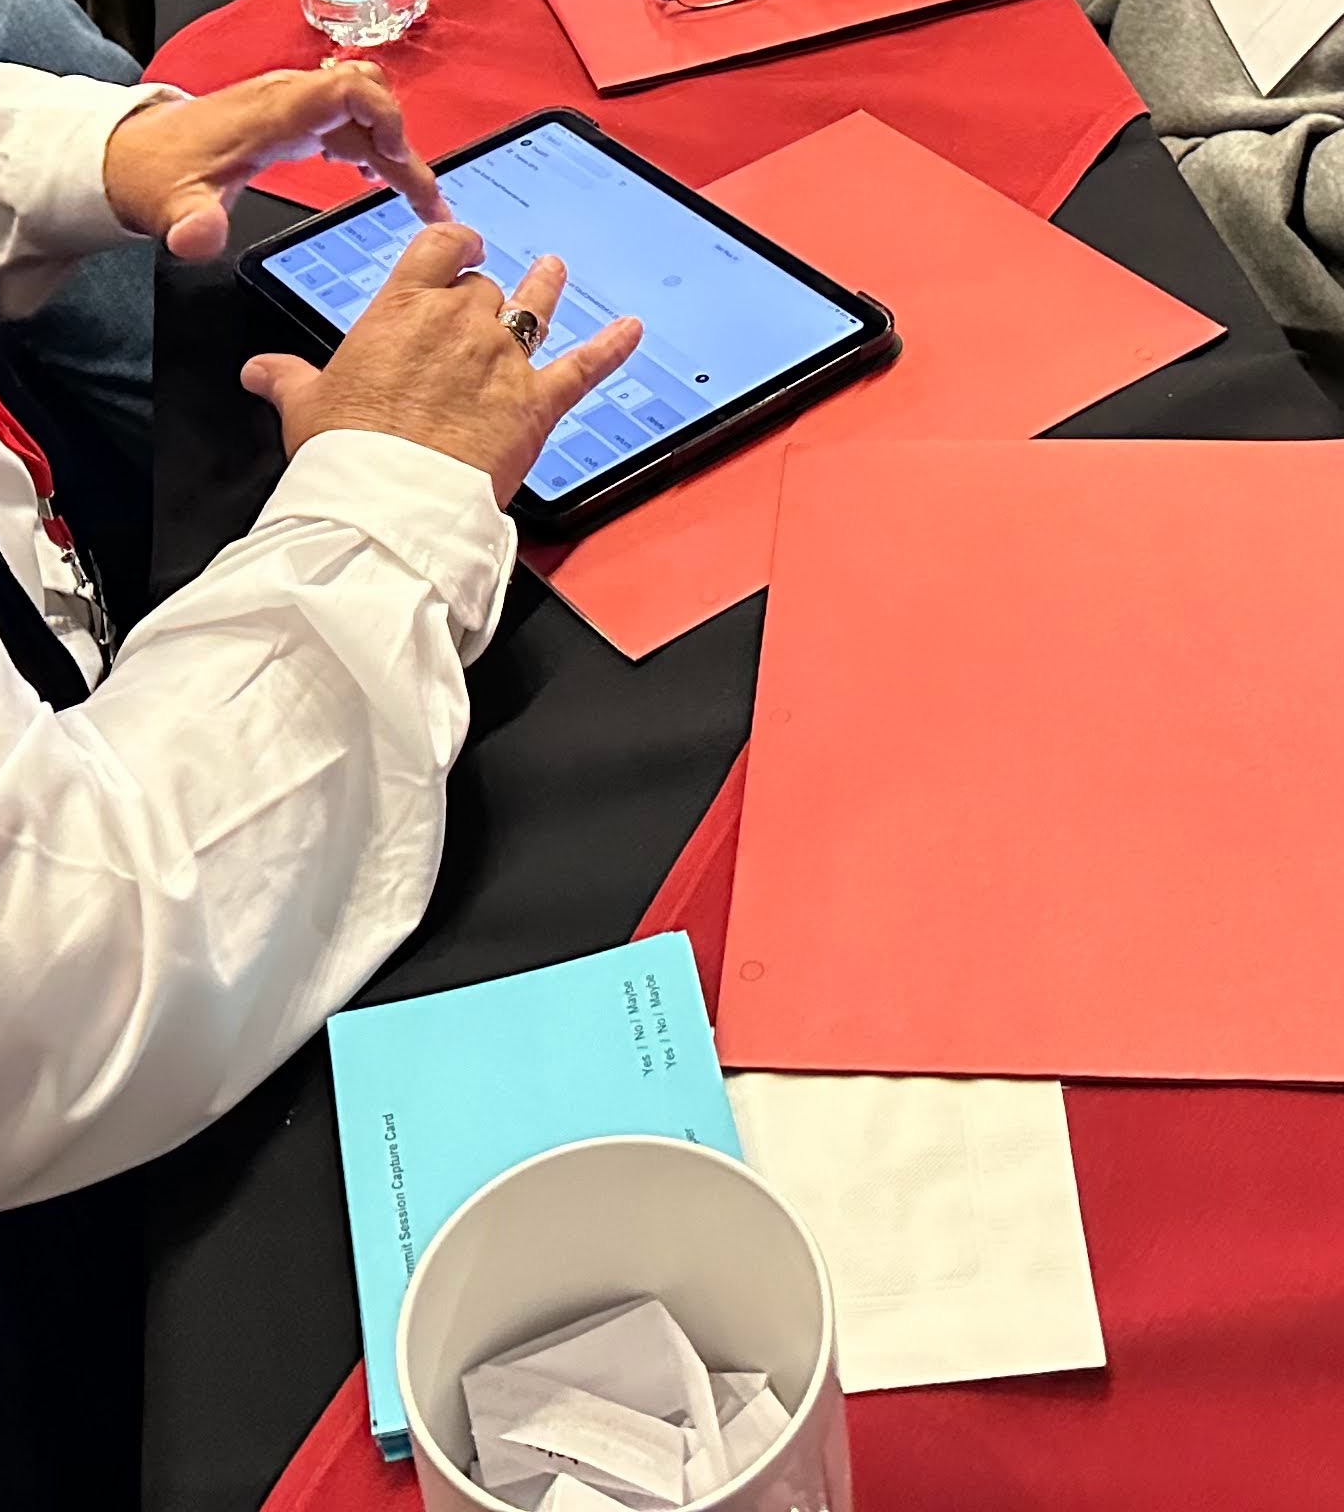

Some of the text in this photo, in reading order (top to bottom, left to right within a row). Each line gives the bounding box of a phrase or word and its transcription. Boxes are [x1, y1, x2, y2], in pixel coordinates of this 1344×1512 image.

[622, 980, 641, 1016] Maybe
[644, 973, 663, 1009] Maybe
[632, 1024, 647, 1042] No
[655, 1017, 670, 1035] No
[641, 1053, 655, 1078] Yes
[663, 1046, 678, 1071] Yes
[382, 1113, 398, 1141] Card
[390, 1143, 406, 1189] Capture
[396, 1192, 412, 1241] Session
